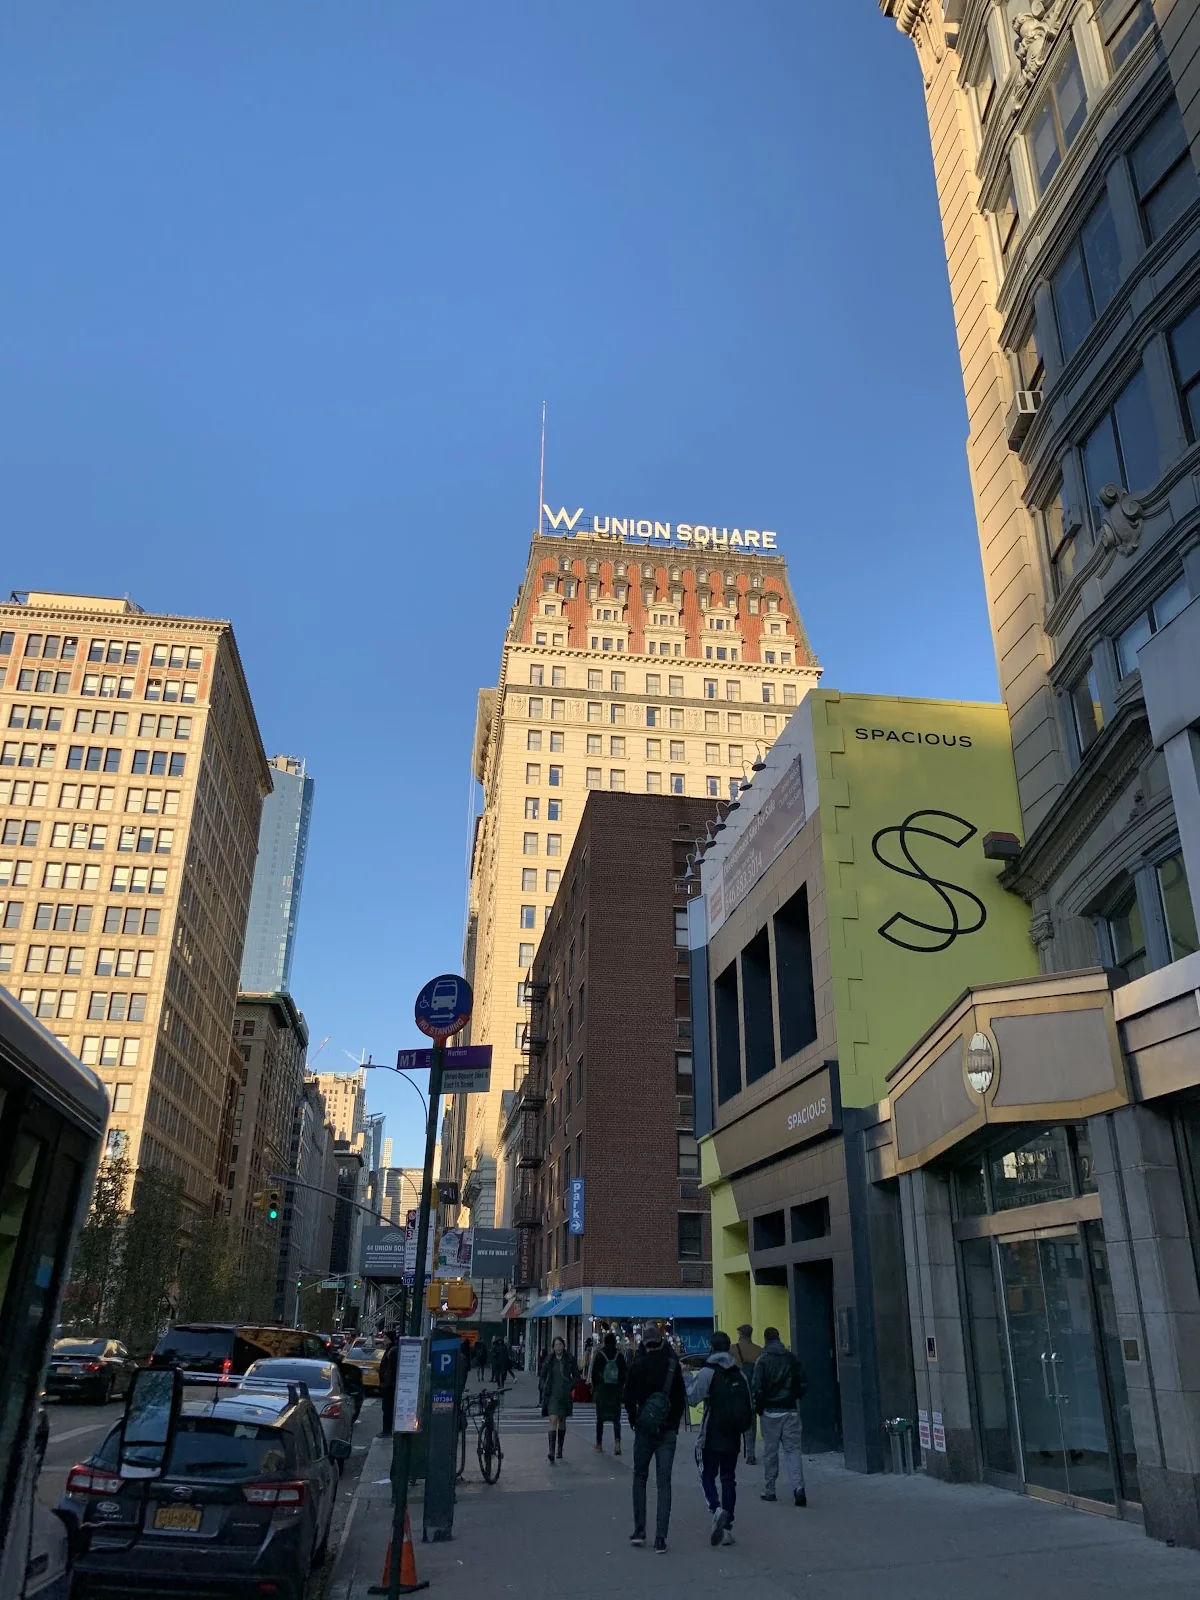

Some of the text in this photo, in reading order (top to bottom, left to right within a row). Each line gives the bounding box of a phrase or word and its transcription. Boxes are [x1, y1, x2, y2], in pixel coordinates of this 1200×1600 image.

[543, 504, 777, 549] W UNION SQUARE
[855, 727, 973, 749] SPACIOUS
[418, 1018, 465, 1035] NO STANDING
[400, 1052, 416, 1067] M1
[447, 1049, 468, 1057] Harlem
[787, 1097, 827, 1131] SPACIOUS
[572, 1183, 581, 1219] Park
[374, 1244, 393, 1252] UNION
[440, 1353, 452, 1373] P
